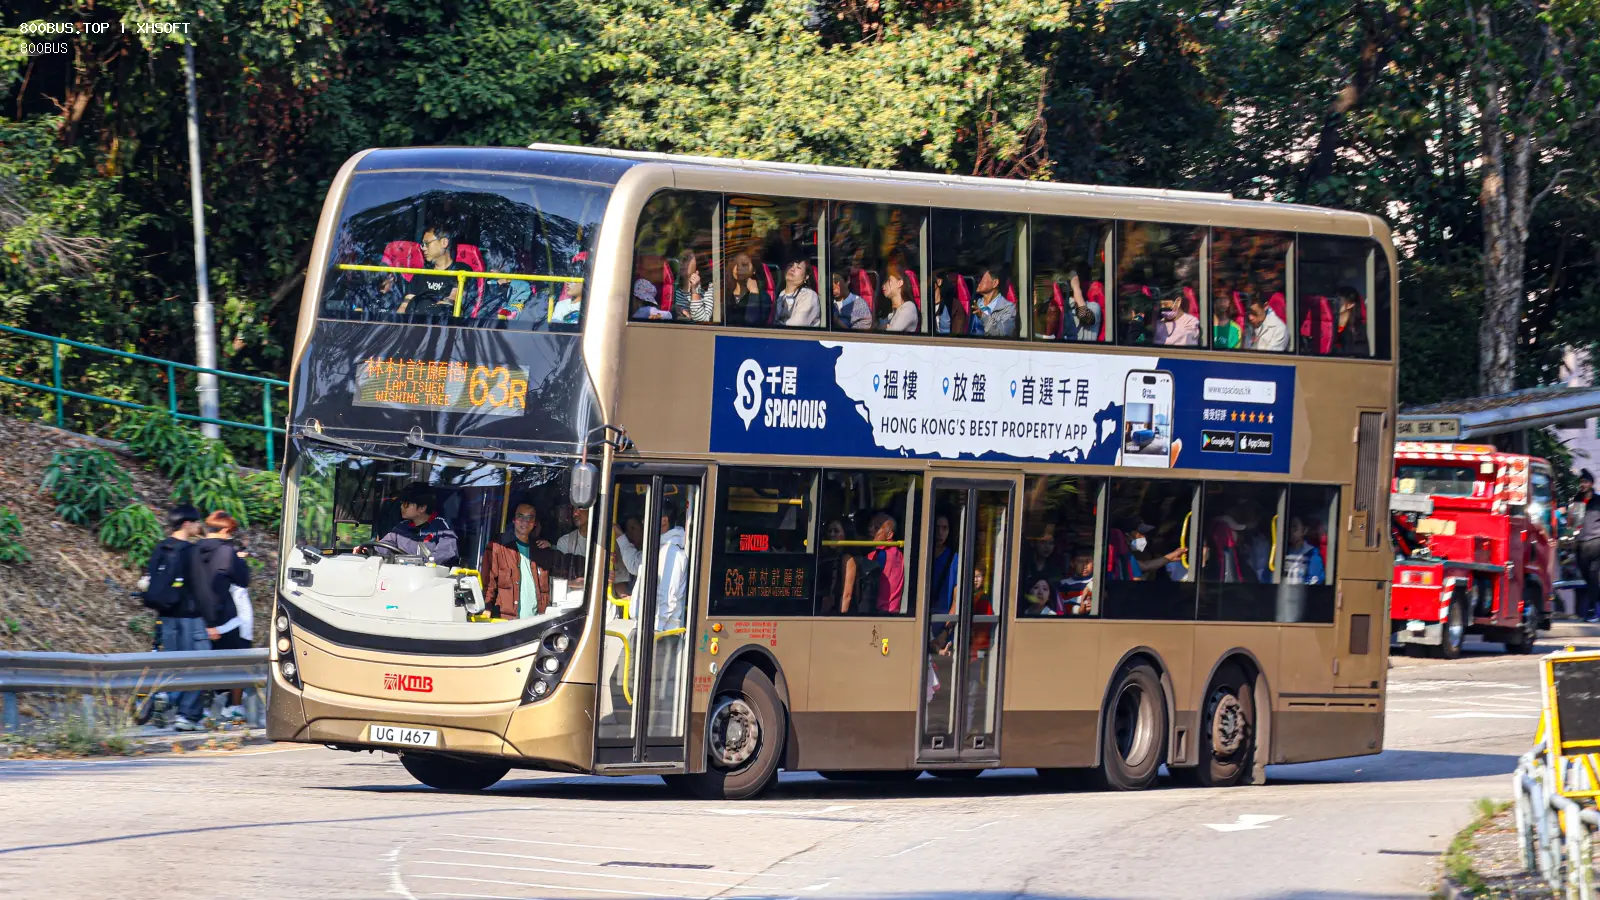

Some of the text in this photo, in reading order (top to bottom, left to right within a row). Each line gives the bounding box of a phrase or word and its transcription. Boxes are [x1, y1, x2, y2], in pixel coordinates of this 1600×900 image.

[364, 356, 469, 383] 林村許願樹
[765, 366, 798, 395] 千居
[375, 390, 452, 407] WISHING TREE
[385, 379, 445, 394] LAM TSUEN
[468, 365, 529, 409] 63R
[952, 372, 986, 403] 放盤
[1021, 375, 1090, 408] 首選千居
[764, 398, 827, 430] SPACIOUS
[880, 416, 1088, 441] HONG KONG'S BEST PROPERTY APP
[748, 534, 769, 551] KMB
[725, 568, 744, 597] 63R
[398, 674, 433, 693] KMB
[376, 727, 430, 745] UG 1467
